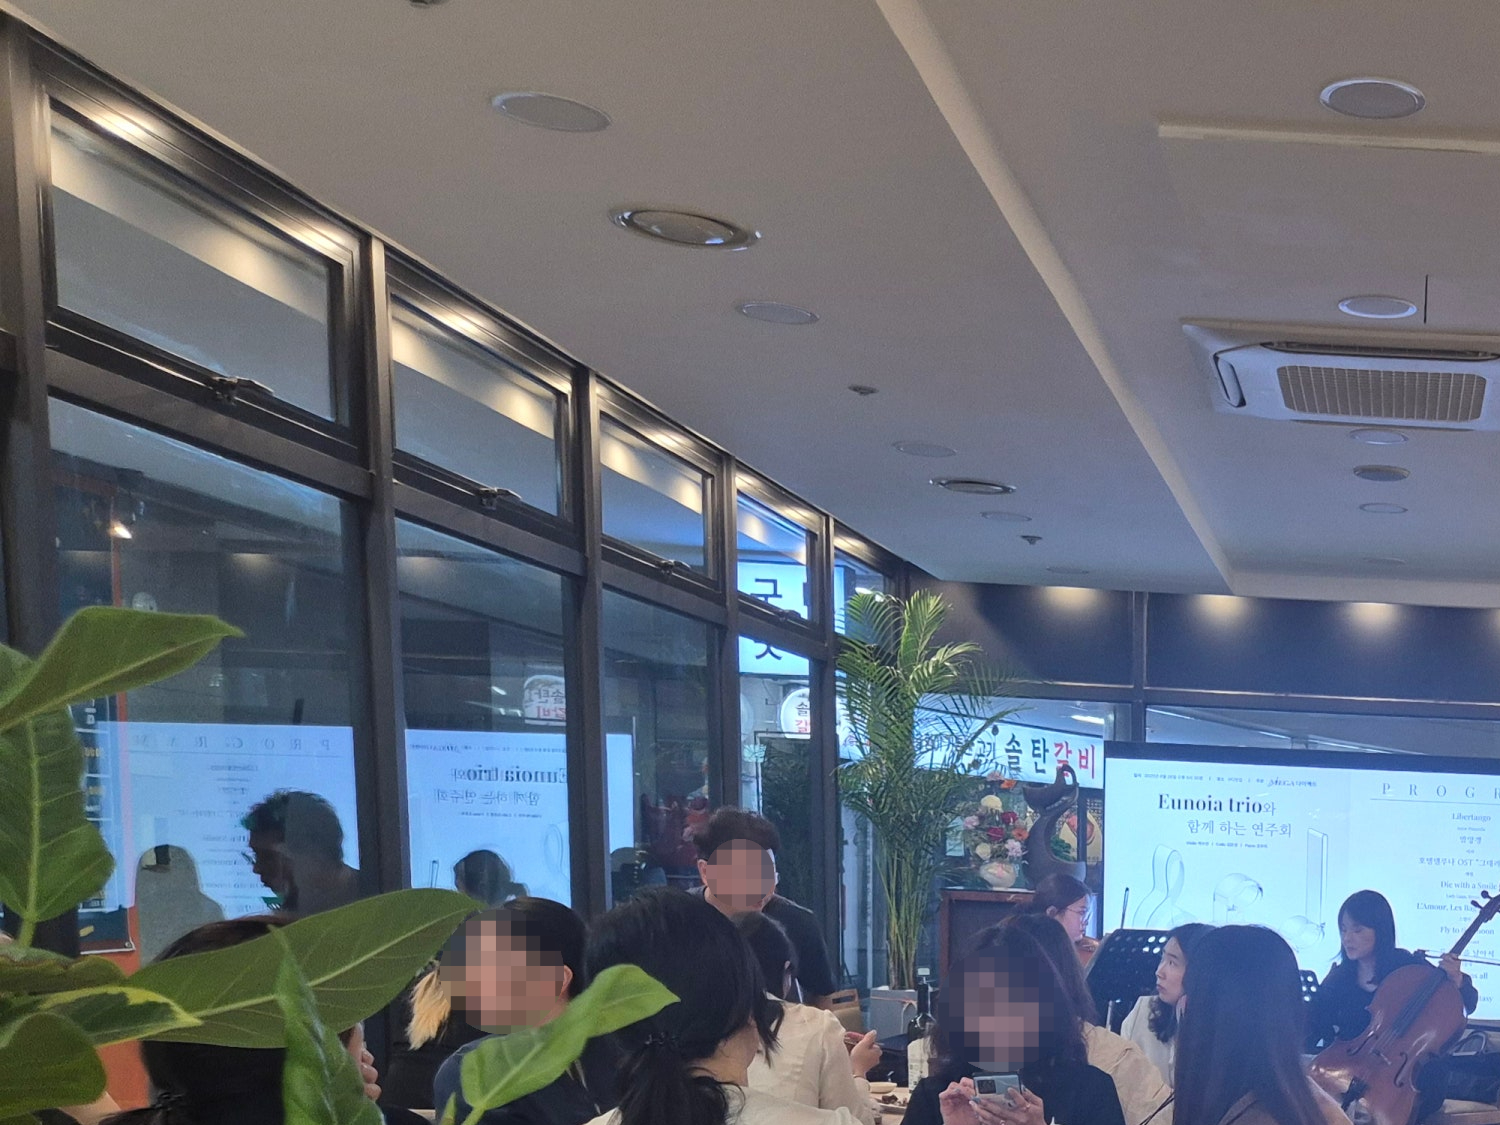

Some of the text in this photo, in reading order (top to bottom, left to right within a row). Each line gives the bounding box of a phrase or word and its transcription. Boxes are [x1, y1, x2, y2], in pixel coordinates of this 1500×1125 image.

[1158, 793, 1276, 817] Eunoia trio와
[1451, 812, 1492, 822] Libertango
[1187, 819, 1292, 839] 함께 하는 연주회
[1454, 881, 1471, 889] with
